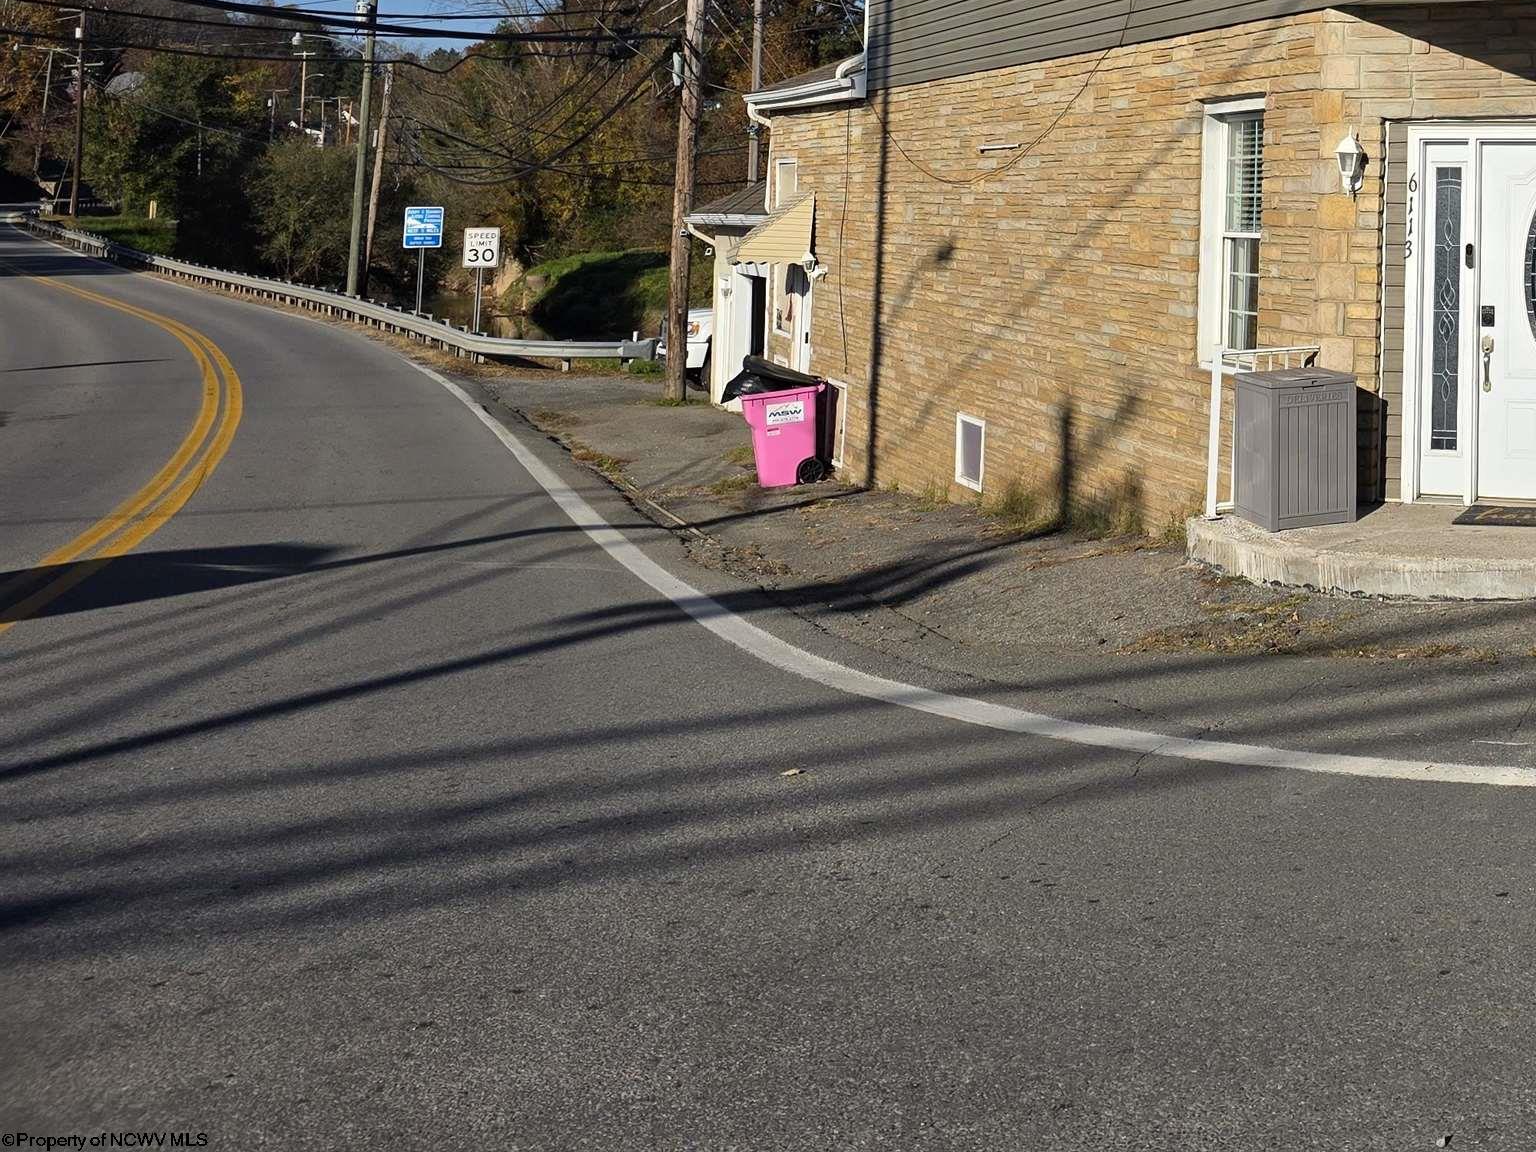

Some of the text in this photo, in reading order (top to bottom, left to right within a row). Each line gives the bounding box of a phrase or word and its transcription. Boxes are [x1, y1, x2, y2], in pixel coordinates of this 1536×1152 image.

[1404, 172, 1417, 260] 6113
[467, 248, 495, 262] 30
[768, 409, 802, 418] MSW
